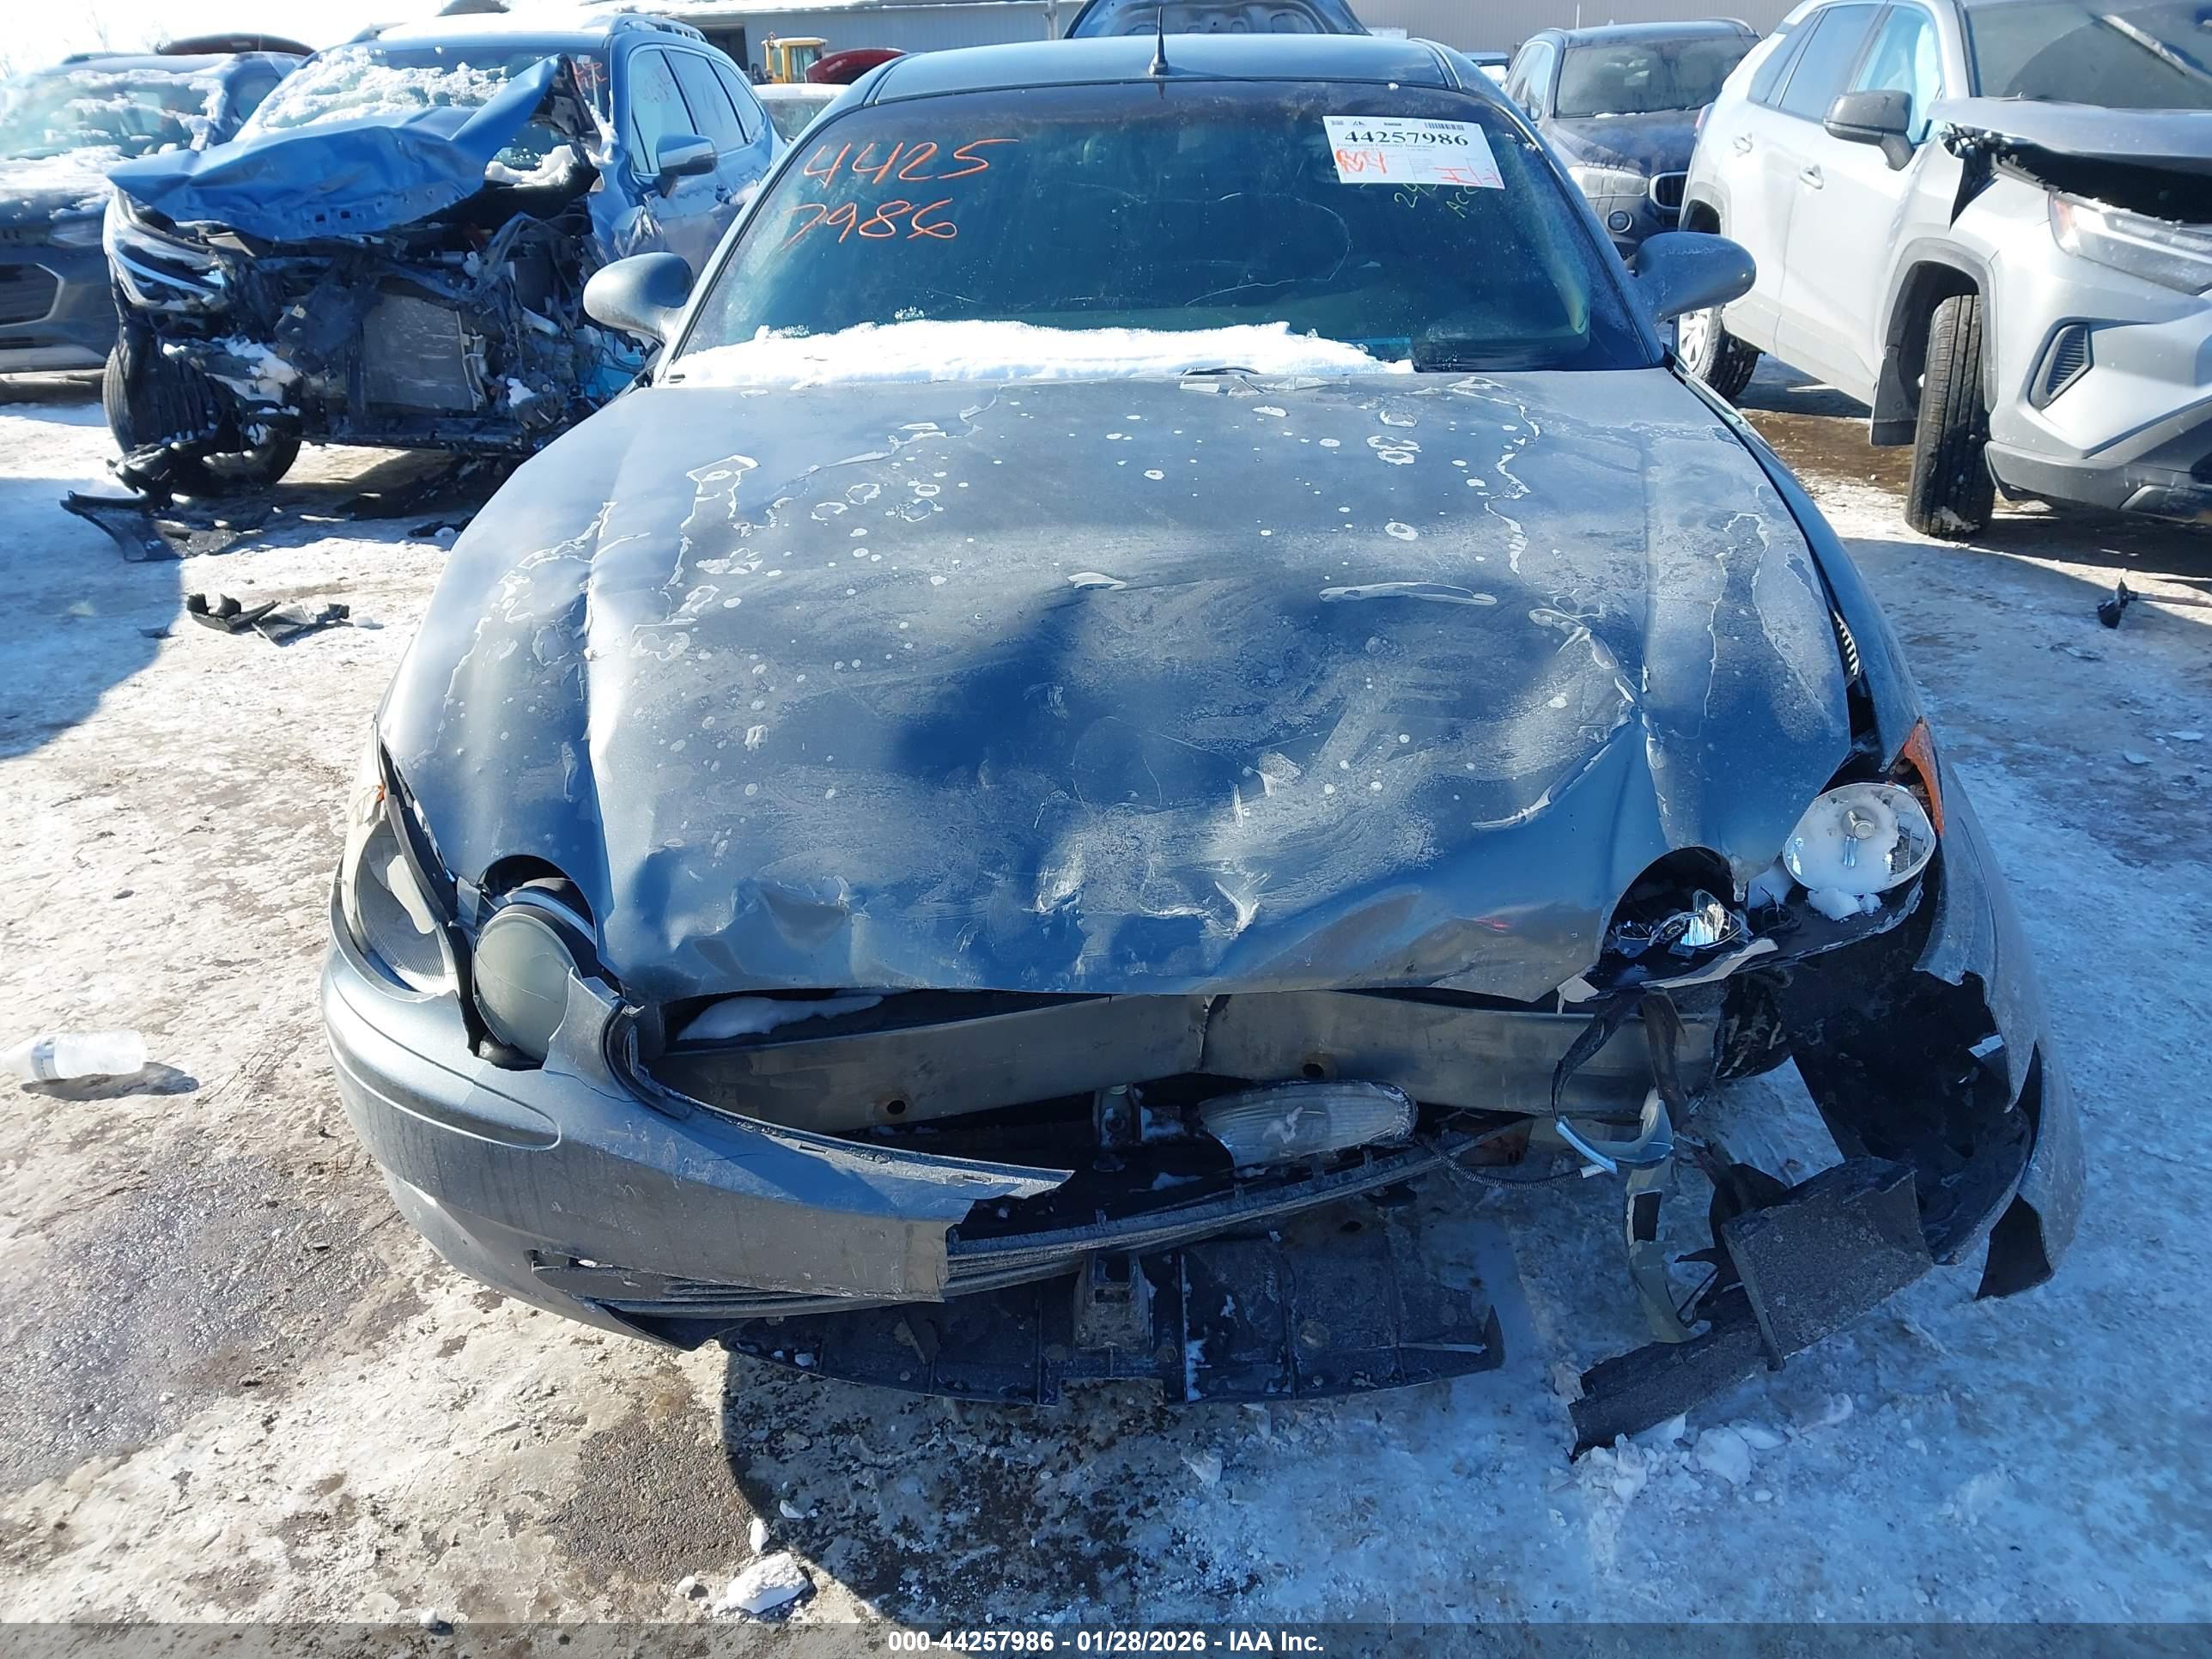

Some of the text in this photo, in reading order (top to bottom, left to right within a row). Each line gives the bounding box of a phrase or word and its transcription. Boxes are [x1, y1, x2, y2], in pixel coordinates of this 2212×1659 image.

[1345, 131, 1469, 146] 44257986
[804, 139, 1019, 189] 4425
[780, 198, 958, 251] 7986
